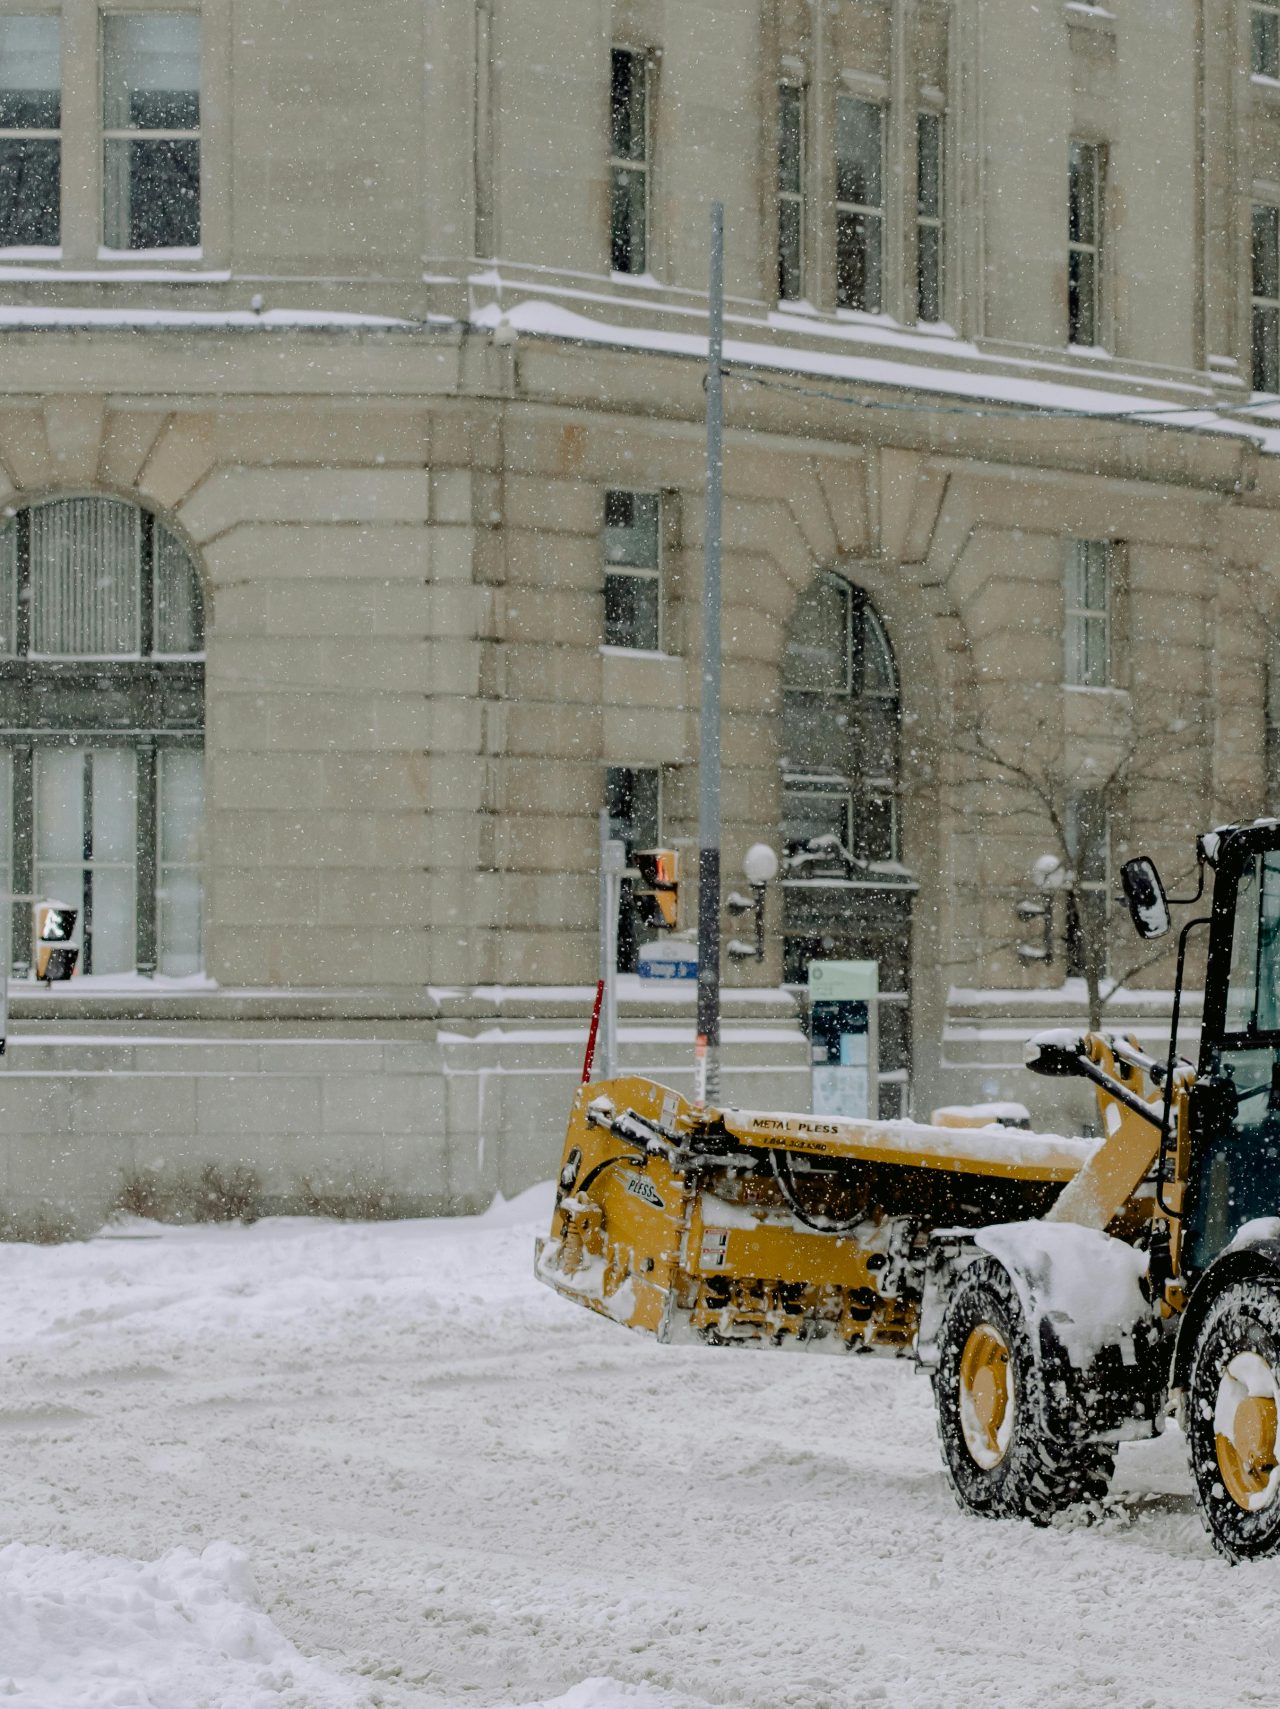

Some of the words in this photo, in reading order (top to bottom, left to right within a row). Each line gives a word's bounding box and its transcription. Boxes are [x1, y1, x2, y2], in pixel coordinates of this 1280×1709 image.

[752, 1119, 792, 1131] METAL
[798, 1123, 839, 1134] PLESS
[627, 1179, 654, 1197] PLESS
